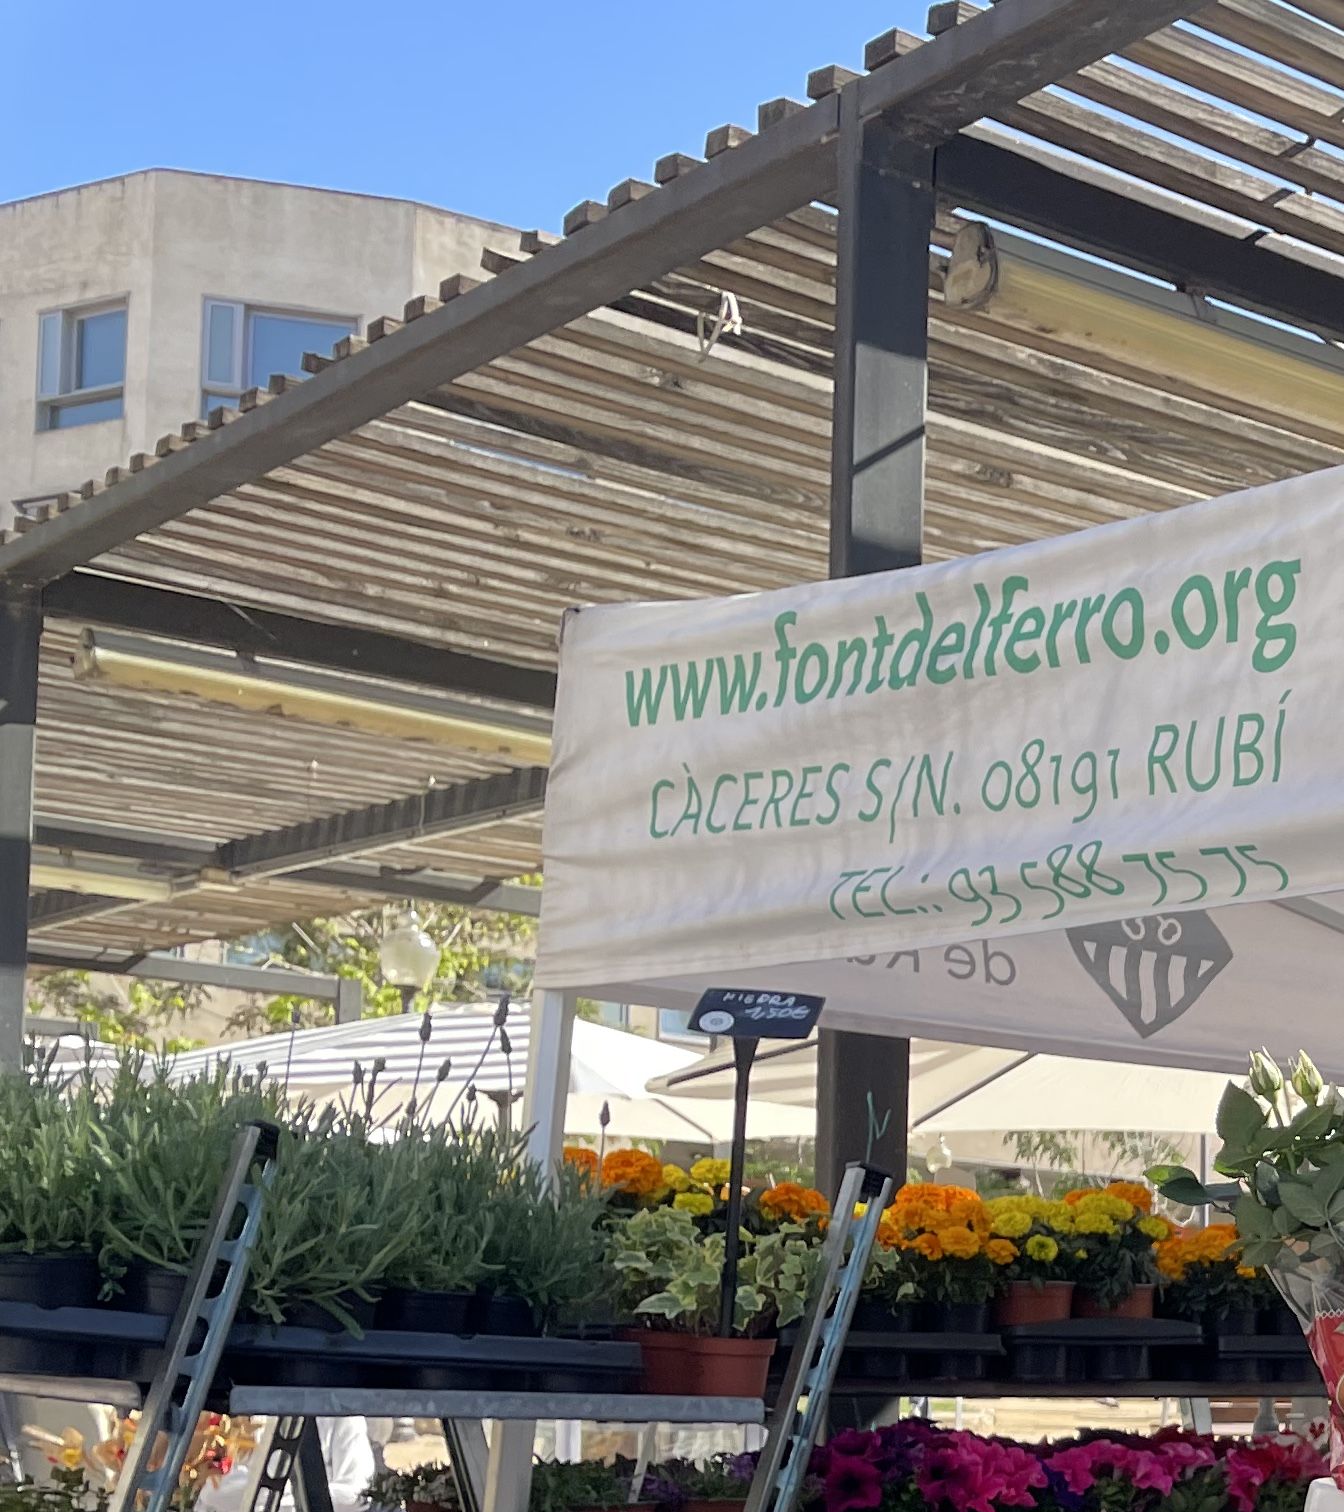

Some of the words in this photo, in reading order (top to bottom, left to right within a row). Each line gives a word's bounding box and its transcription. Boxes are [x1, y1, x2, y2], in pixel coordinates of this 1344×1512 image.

[625, 558, 1302, 727] www.fontdelferro.org
[648, 761, 850, 839] CÀCERES
[857, 750, 961, 843] S/N.
[980, 737, 1121, 823] 08191
[1146, 688, 1293, 797] RUBÍ
[1021, 839, 1124, 919] 588
